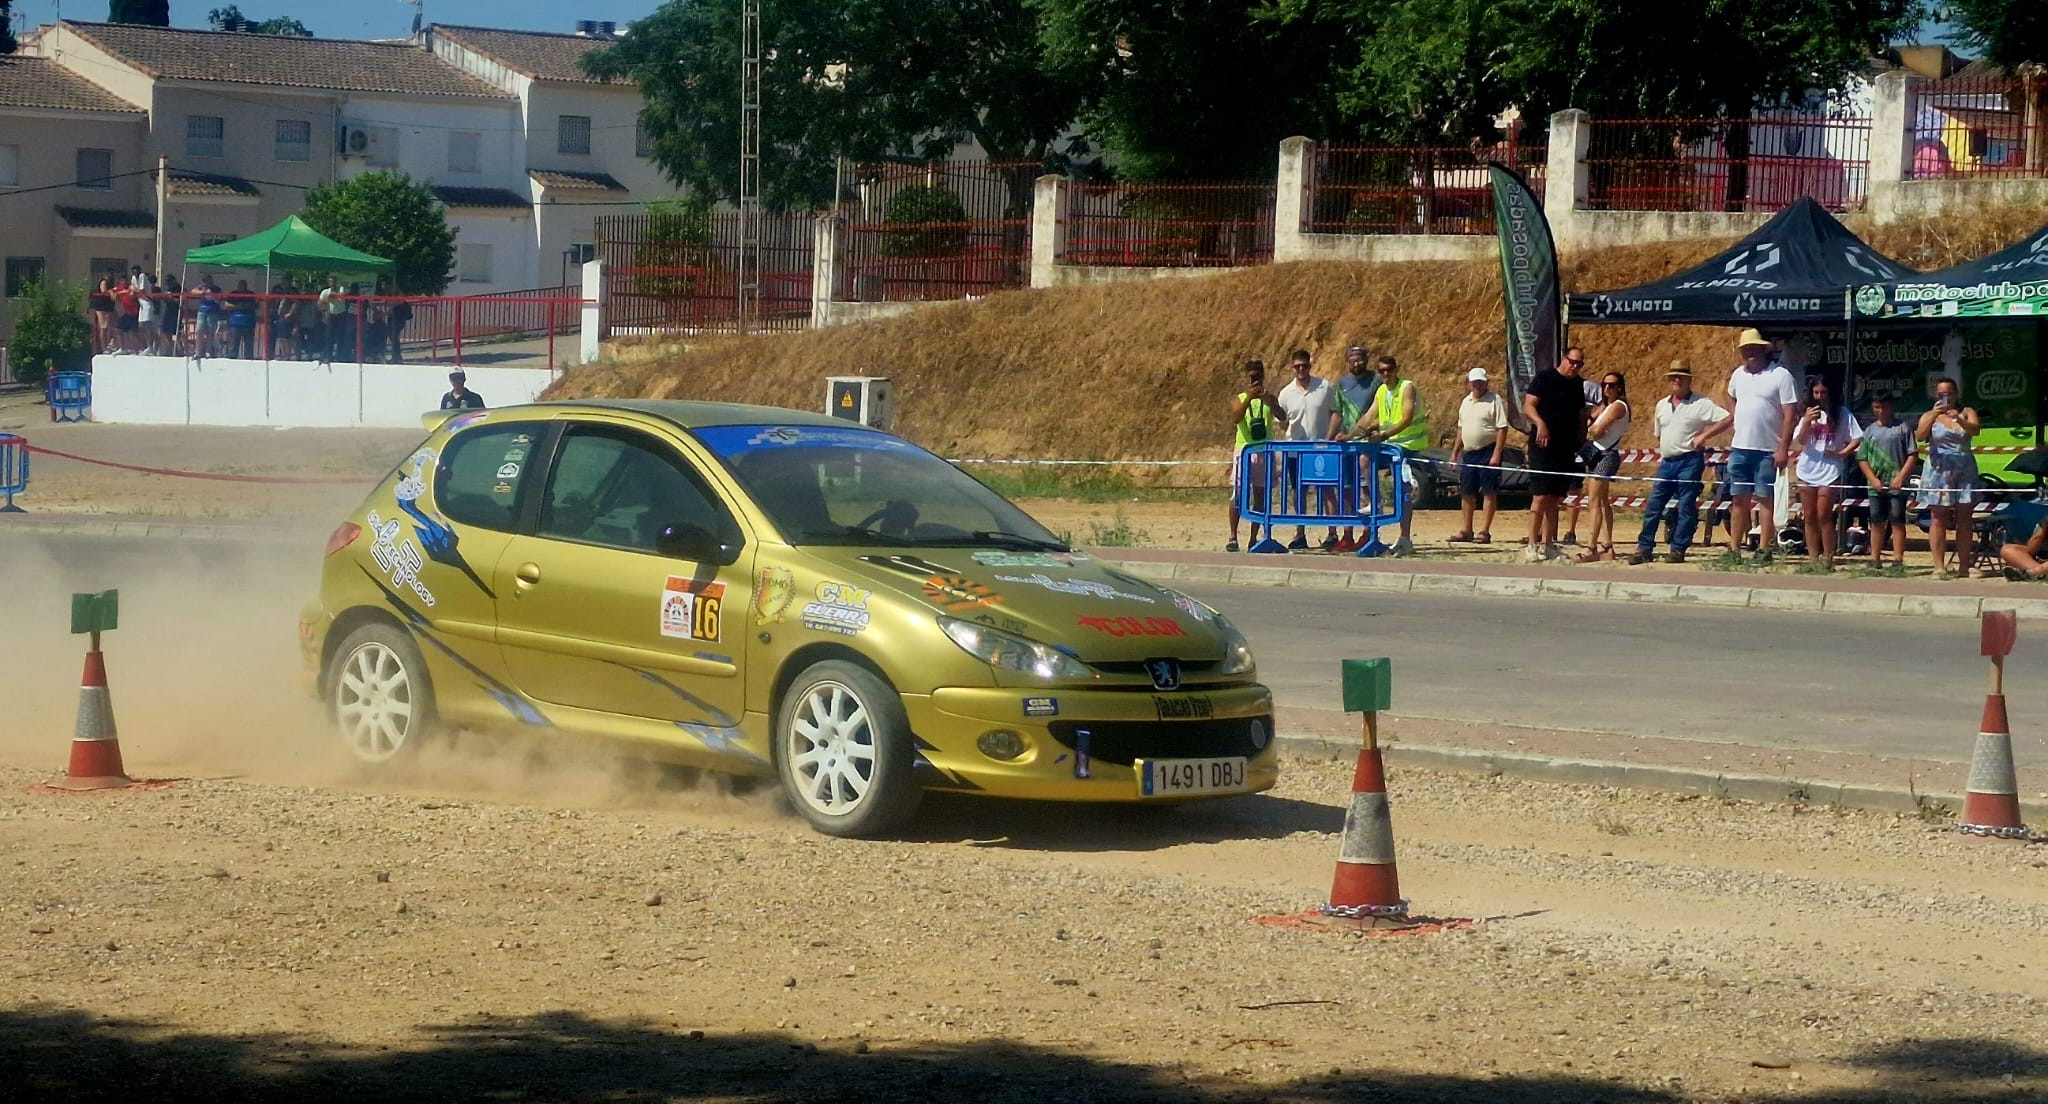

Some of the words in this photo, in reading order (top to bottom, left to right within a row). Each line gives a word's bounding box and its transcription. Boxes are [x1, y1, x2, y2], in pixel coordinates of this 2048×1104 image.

[1675, 278, 1779, 290] XLMOTO
[1614, 299, 1673, 312] XLMOTO
[1758, 298, 1821, 311] XLMOTO
[1981, 375, 2020, 394] CRUZ
[815, 580, 872, 609] CM
[693, 596, 719, 639] 16
[802, 603, 870, 625] GUERRA
[1160, 763, 1204, 790] 1491
[1212, 761, 1244, 787] DBJ
